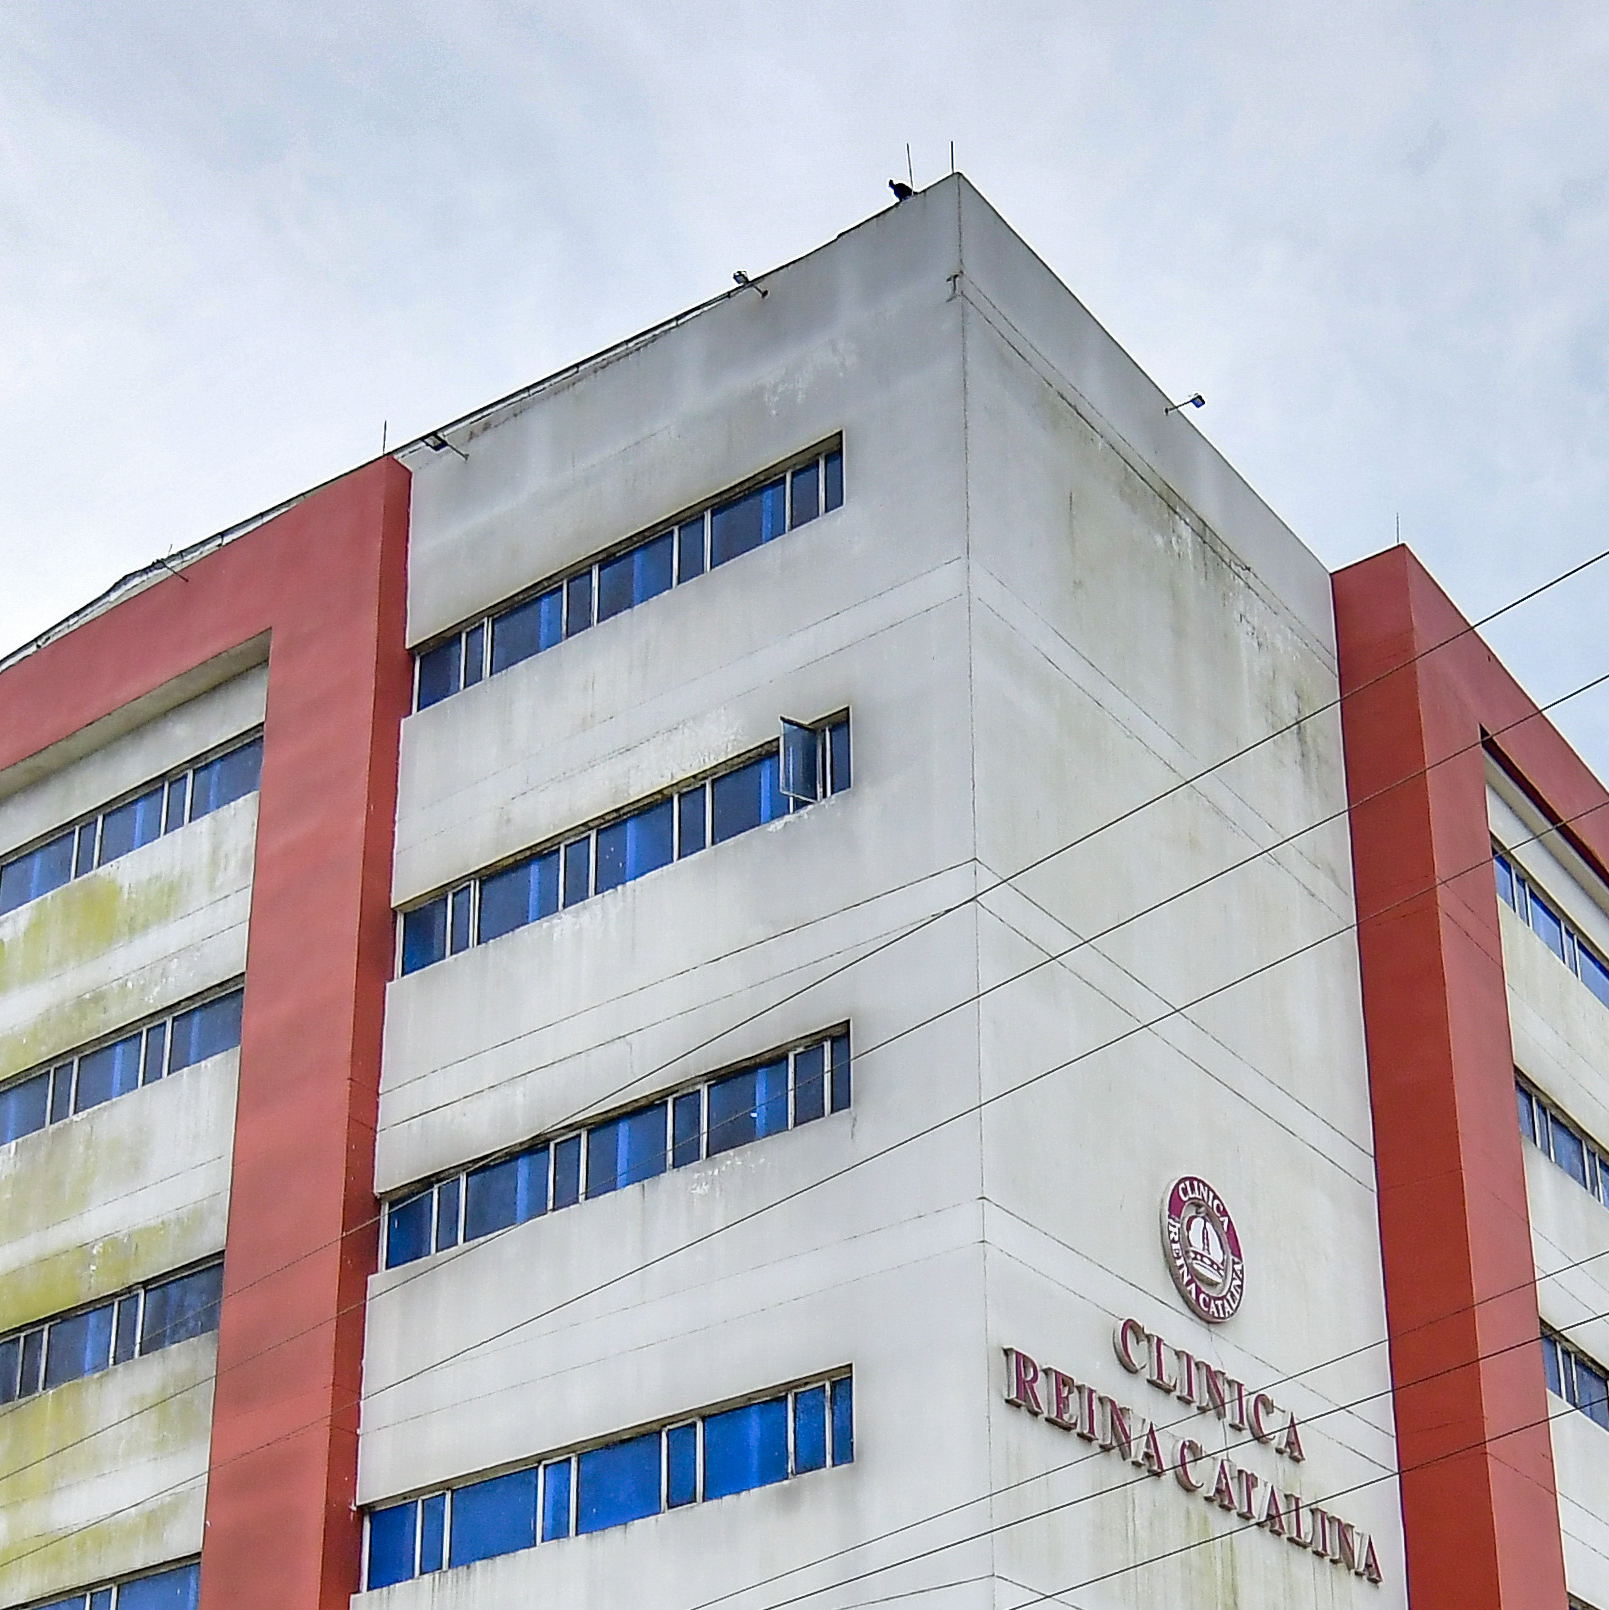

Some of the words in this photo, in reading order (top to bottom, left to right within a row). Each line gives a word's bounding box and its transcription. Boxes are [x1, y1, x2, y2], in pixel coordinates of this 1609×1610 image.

[1178, 1179, 1229, 1233] CLINICA
[1168, 1220, 1197, 1300] REINA
[1199, 1256, 1244, 1319] CATALINA
[1112, 1318, 1307, 1464] CLINICA
[1001, 1345, 1167, 1478] REINA
[1173, 1438, 1384, 1587] CATALINA
